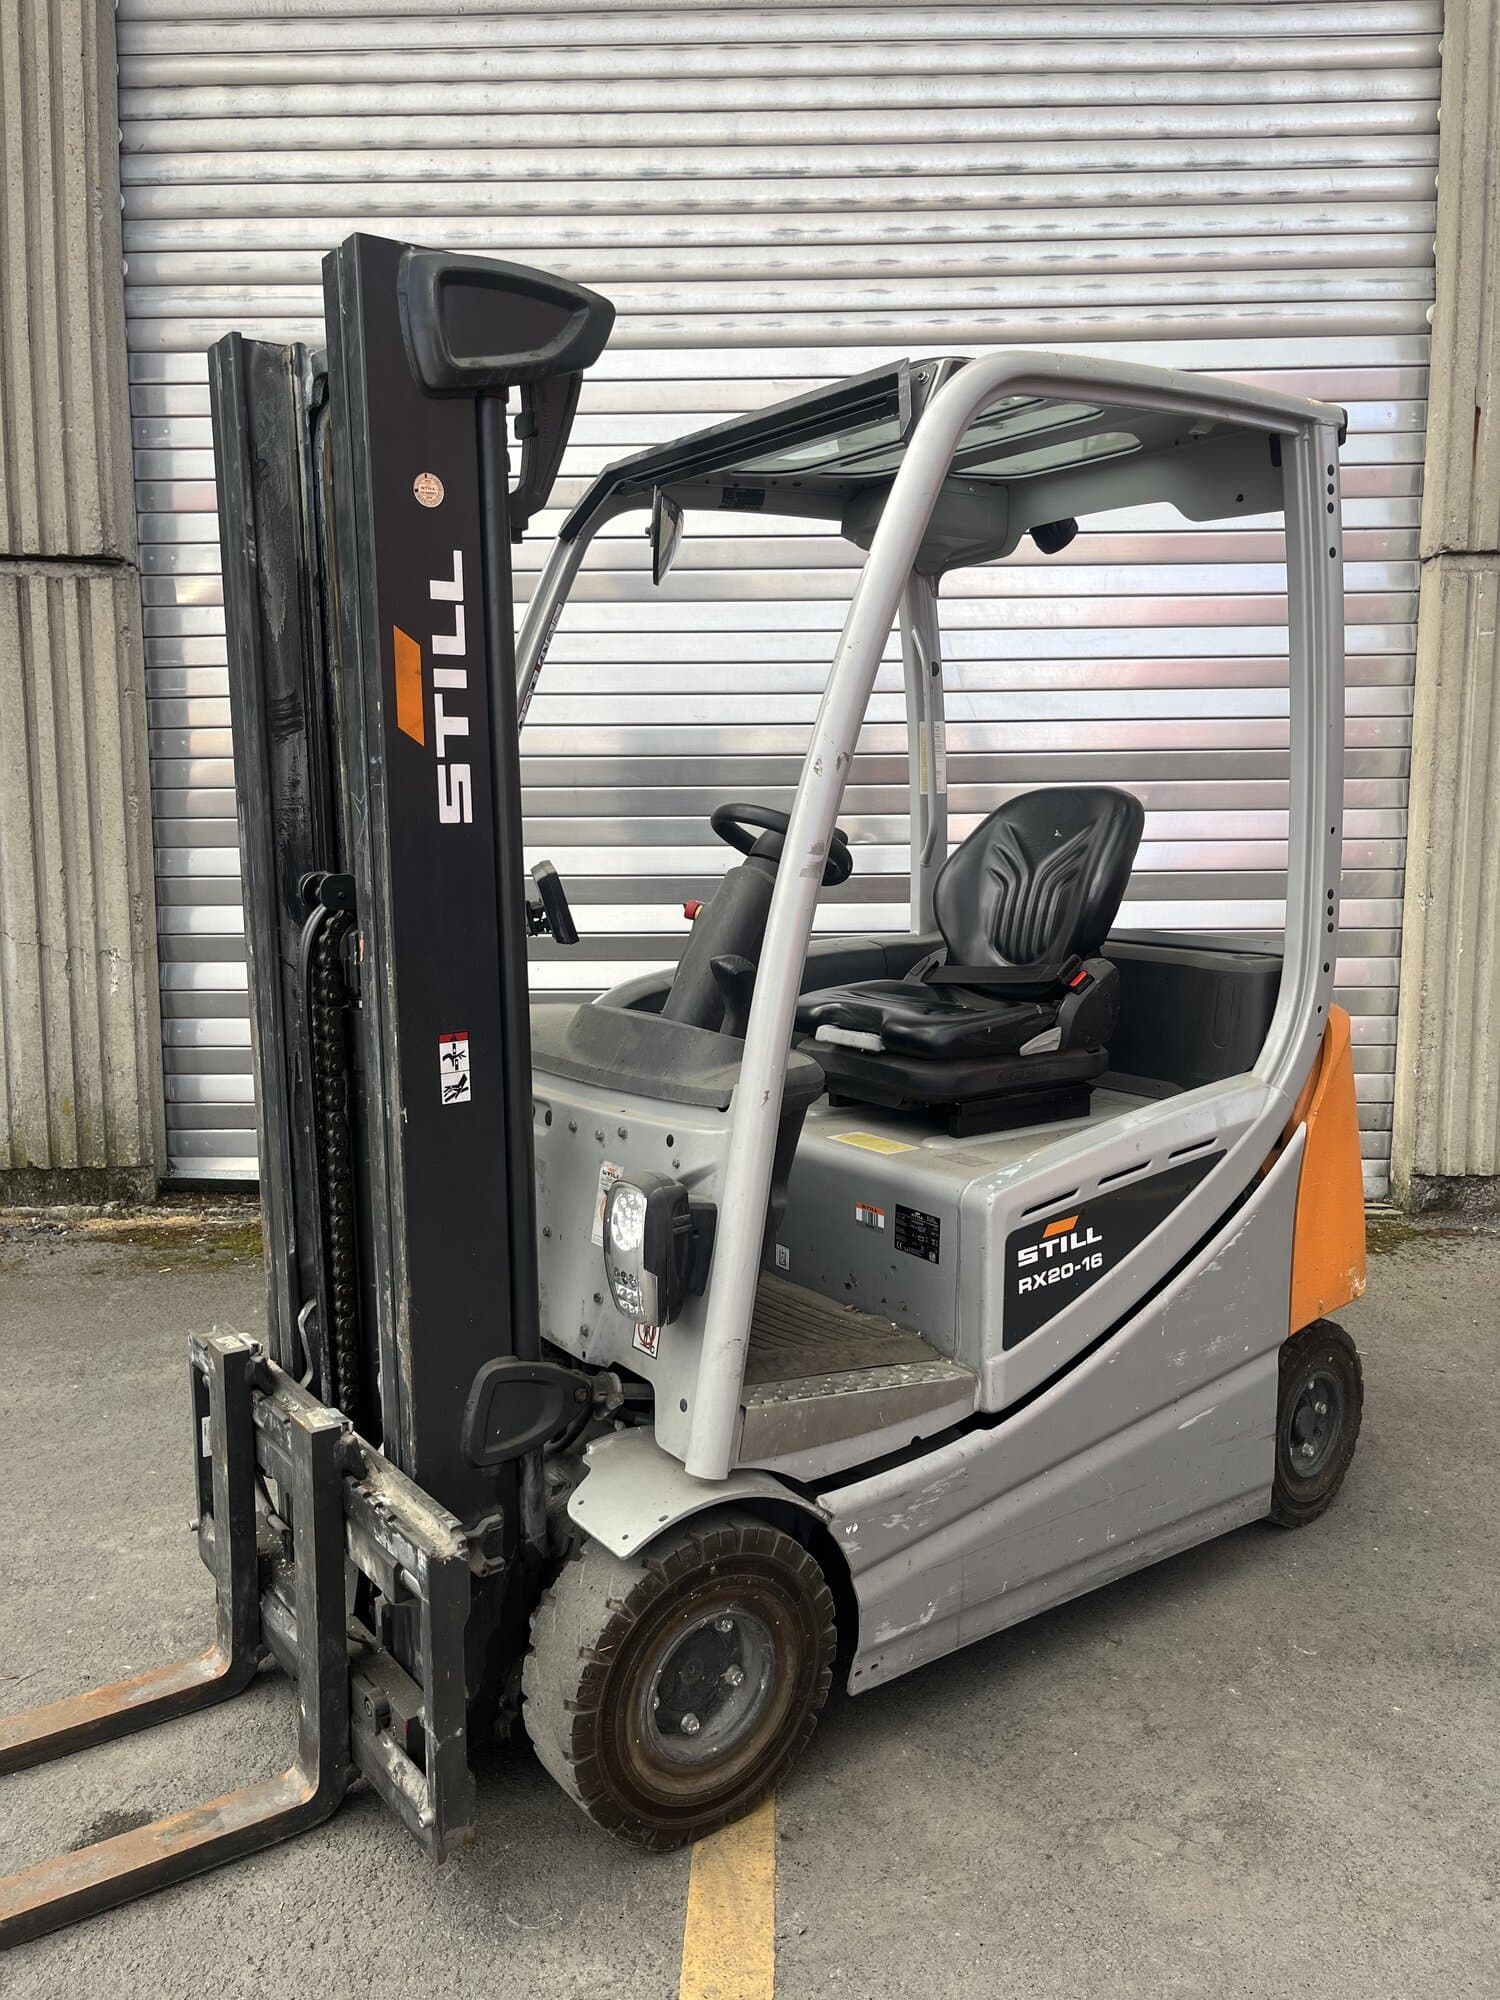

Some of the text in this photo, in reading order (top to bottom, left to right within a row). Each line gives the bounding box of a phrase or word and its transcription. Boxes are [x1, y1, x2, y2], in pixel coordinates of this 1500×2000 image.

[429, 549, 473, 824] STILL
[1017, 1227, 1103, 1267] STILL
[1018, 1252, 1104, 1294] RX20-16
